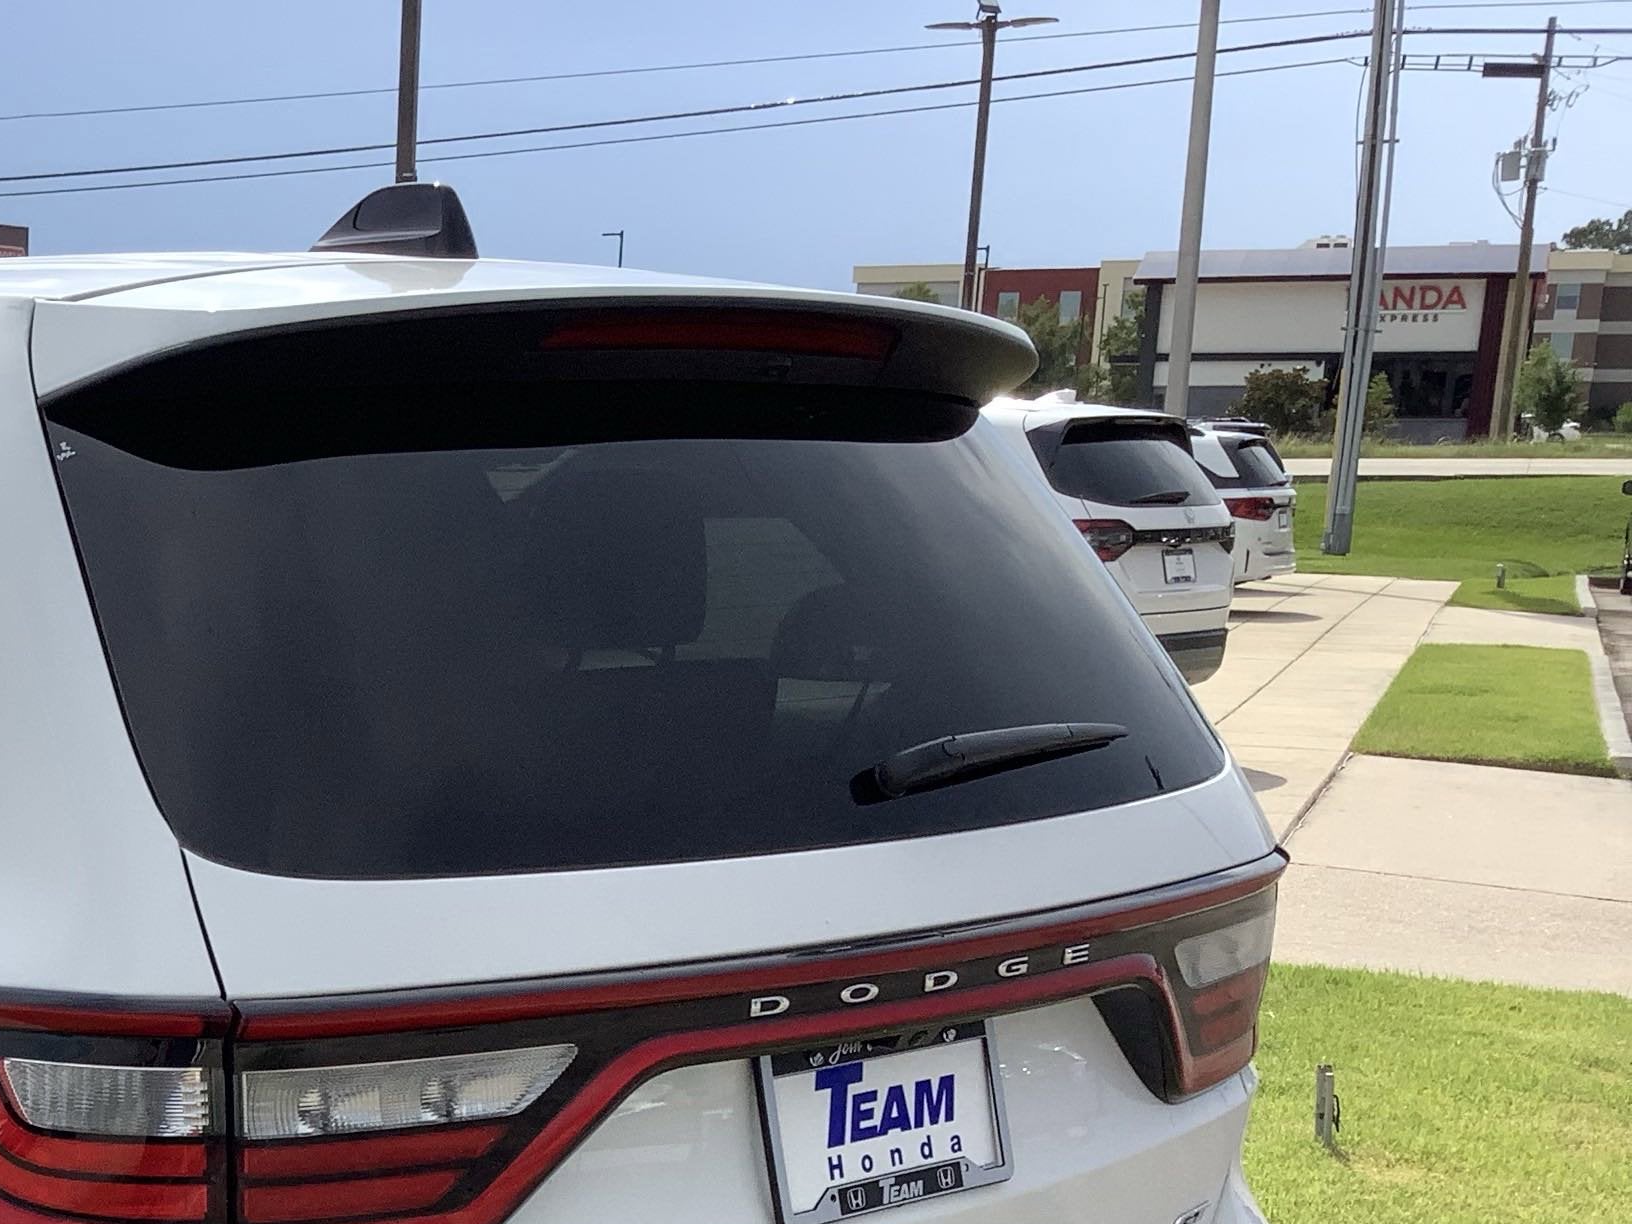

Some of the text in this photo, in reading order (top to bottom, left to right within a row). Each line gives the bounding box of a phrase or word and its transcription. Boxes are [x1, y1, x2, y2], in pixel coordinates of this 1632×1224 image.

[1379, 284, 1467, 310] ANDA
[1379, 312, 1439, 323] XPRESS
[749, 943, 1091, 1018] DODGE
[814, 1061, 955, 1149] TEAM
[827, 1134, 963, 1181] Honda
